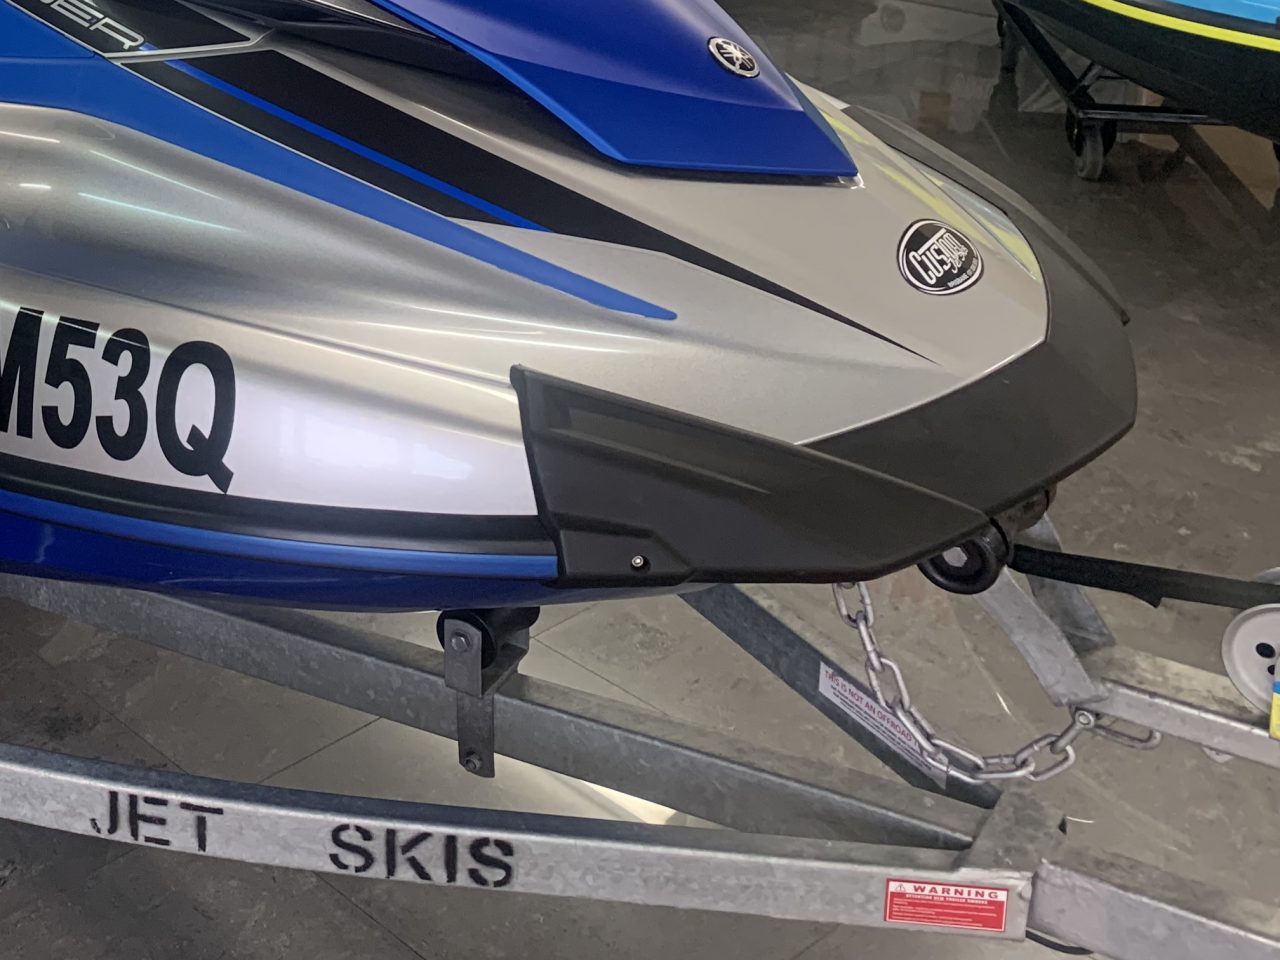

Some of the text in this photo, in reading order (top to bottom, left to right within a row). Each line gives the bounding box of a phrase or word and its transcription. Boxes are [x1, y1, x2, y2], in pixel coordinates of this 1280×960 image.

[848, 688, 864, 705] NOT
[865, 701, 876, 715] AN
[876, 708, 913, 742] OFFROAD
[91, 788, 225, 854] JET
[329, 823, 516, 889] SKIS
[913, 884, 999, 899] WARNING
